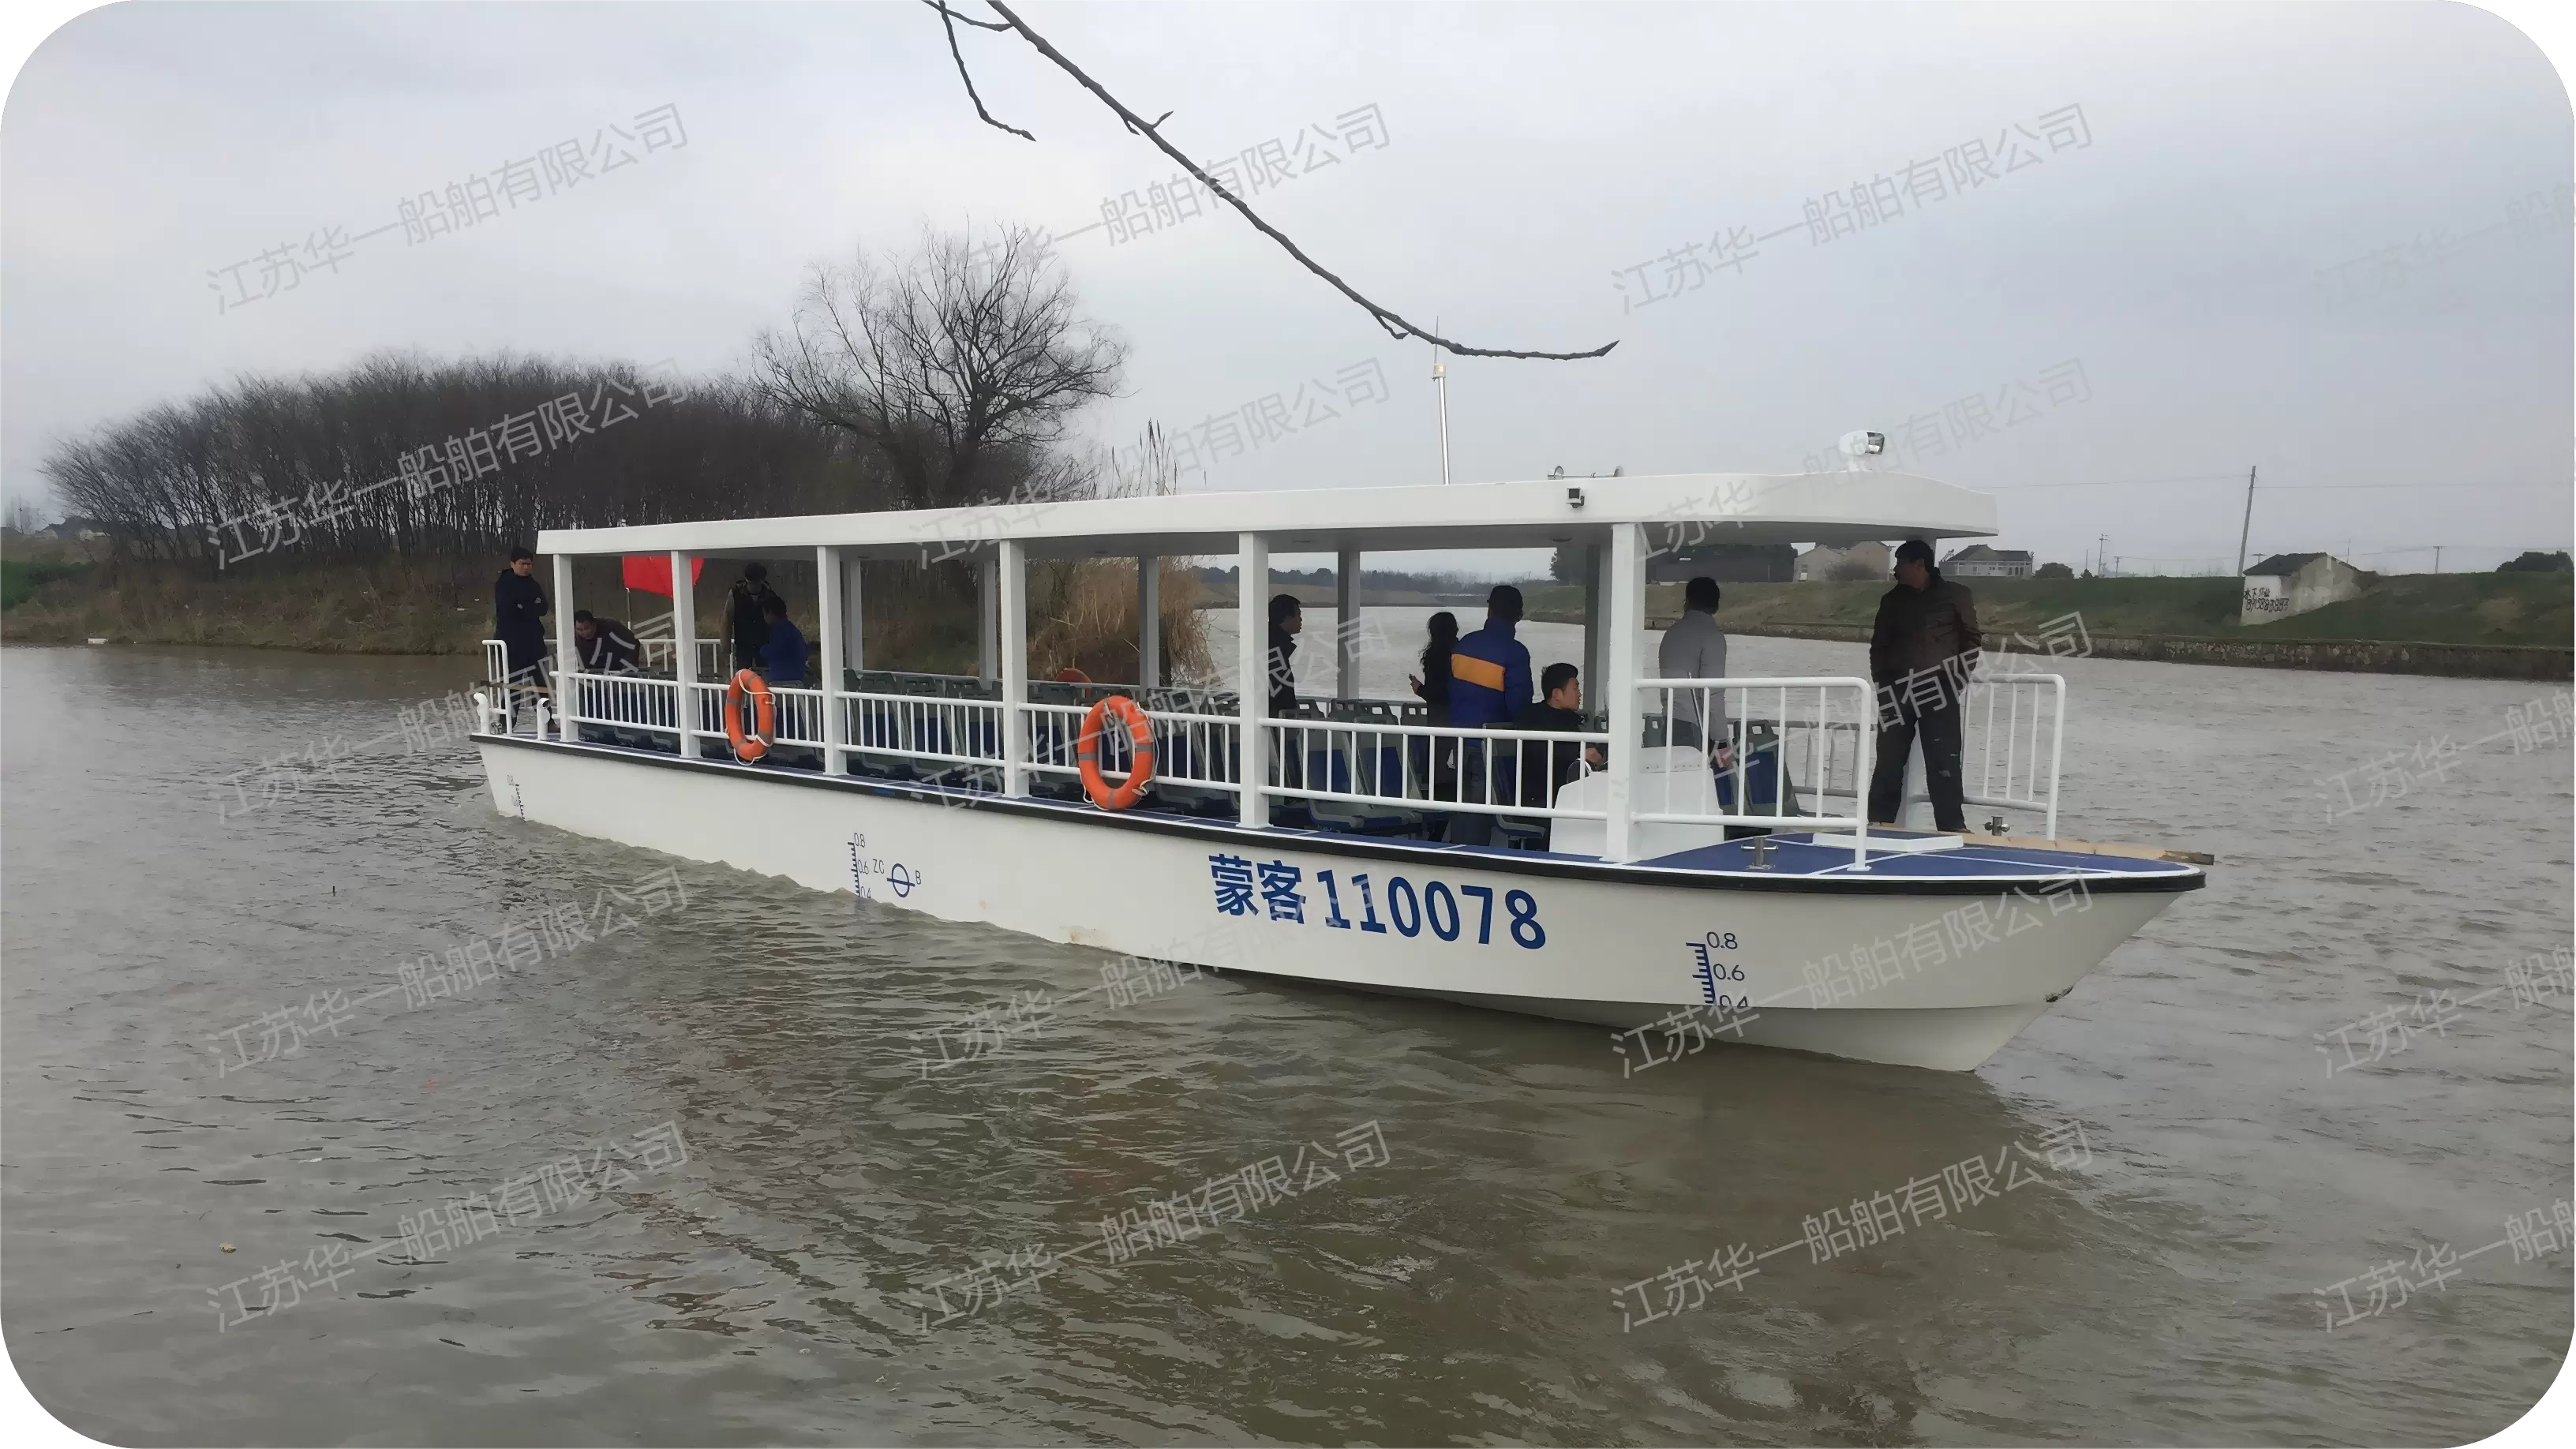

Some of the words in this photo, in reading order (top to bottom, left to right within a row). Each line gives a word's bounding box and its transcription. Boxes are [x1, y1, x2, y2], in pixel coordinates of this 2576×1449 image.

[872, 858, 885, 874] ZC
[915, 870, 922, 885] B
[1208, 853, 1546, 949] 蒙客110078
[1705, 930, 1739, 950] 0.8
[1713, 963, 1746, 982] 0.6
